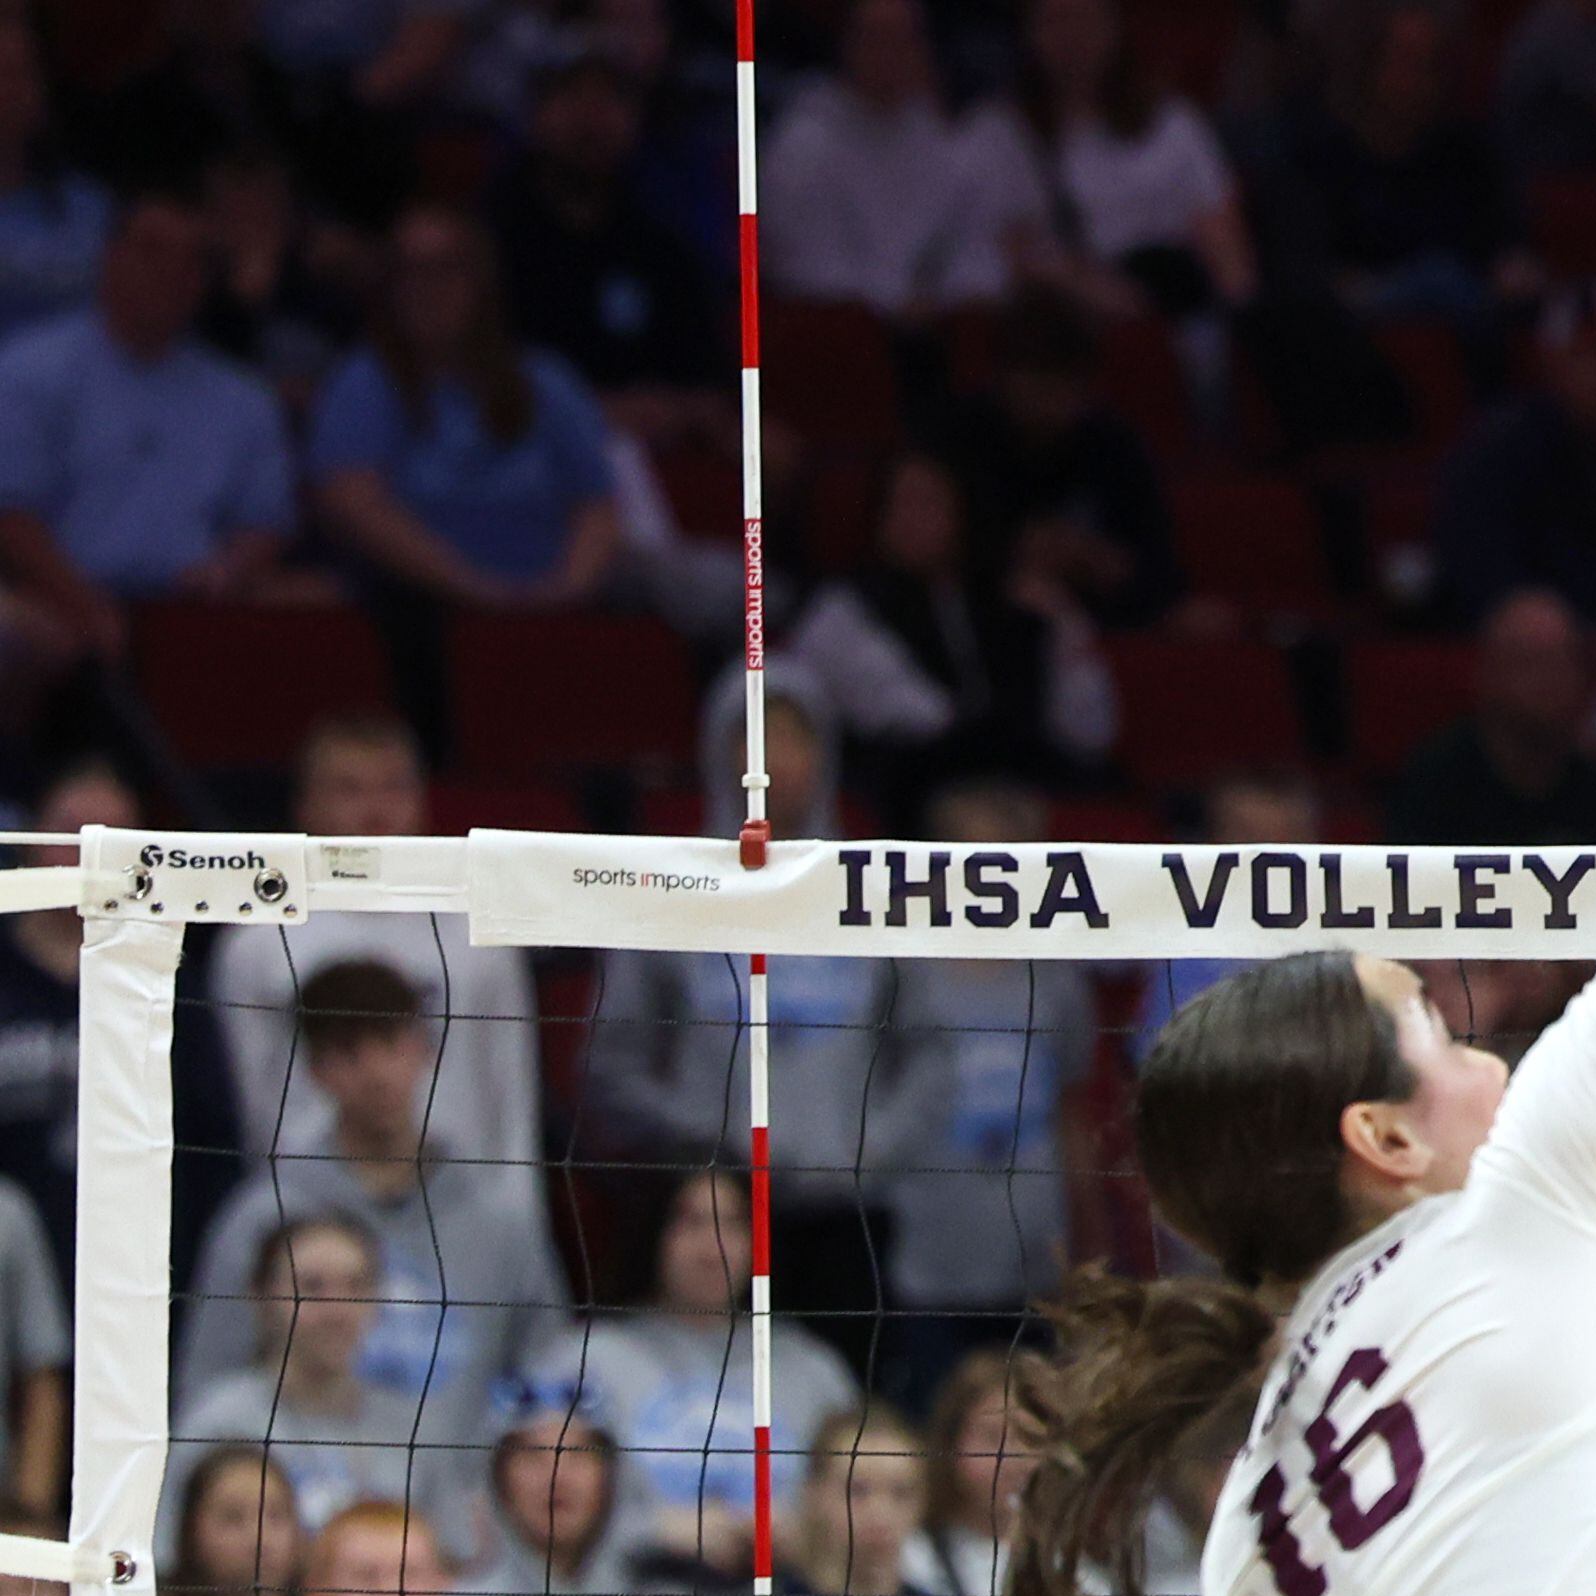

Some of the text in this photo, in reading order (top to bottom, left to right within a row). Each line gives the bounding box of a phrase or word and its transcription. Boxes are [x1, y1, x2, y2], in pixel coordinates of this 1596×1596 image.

[744, 521, 763, 669] sports imports
[168, 851, 265, 869] Senoh
[573, 867, 721, 892] sports imports
[839, 851, 1109, 928] IHSA
